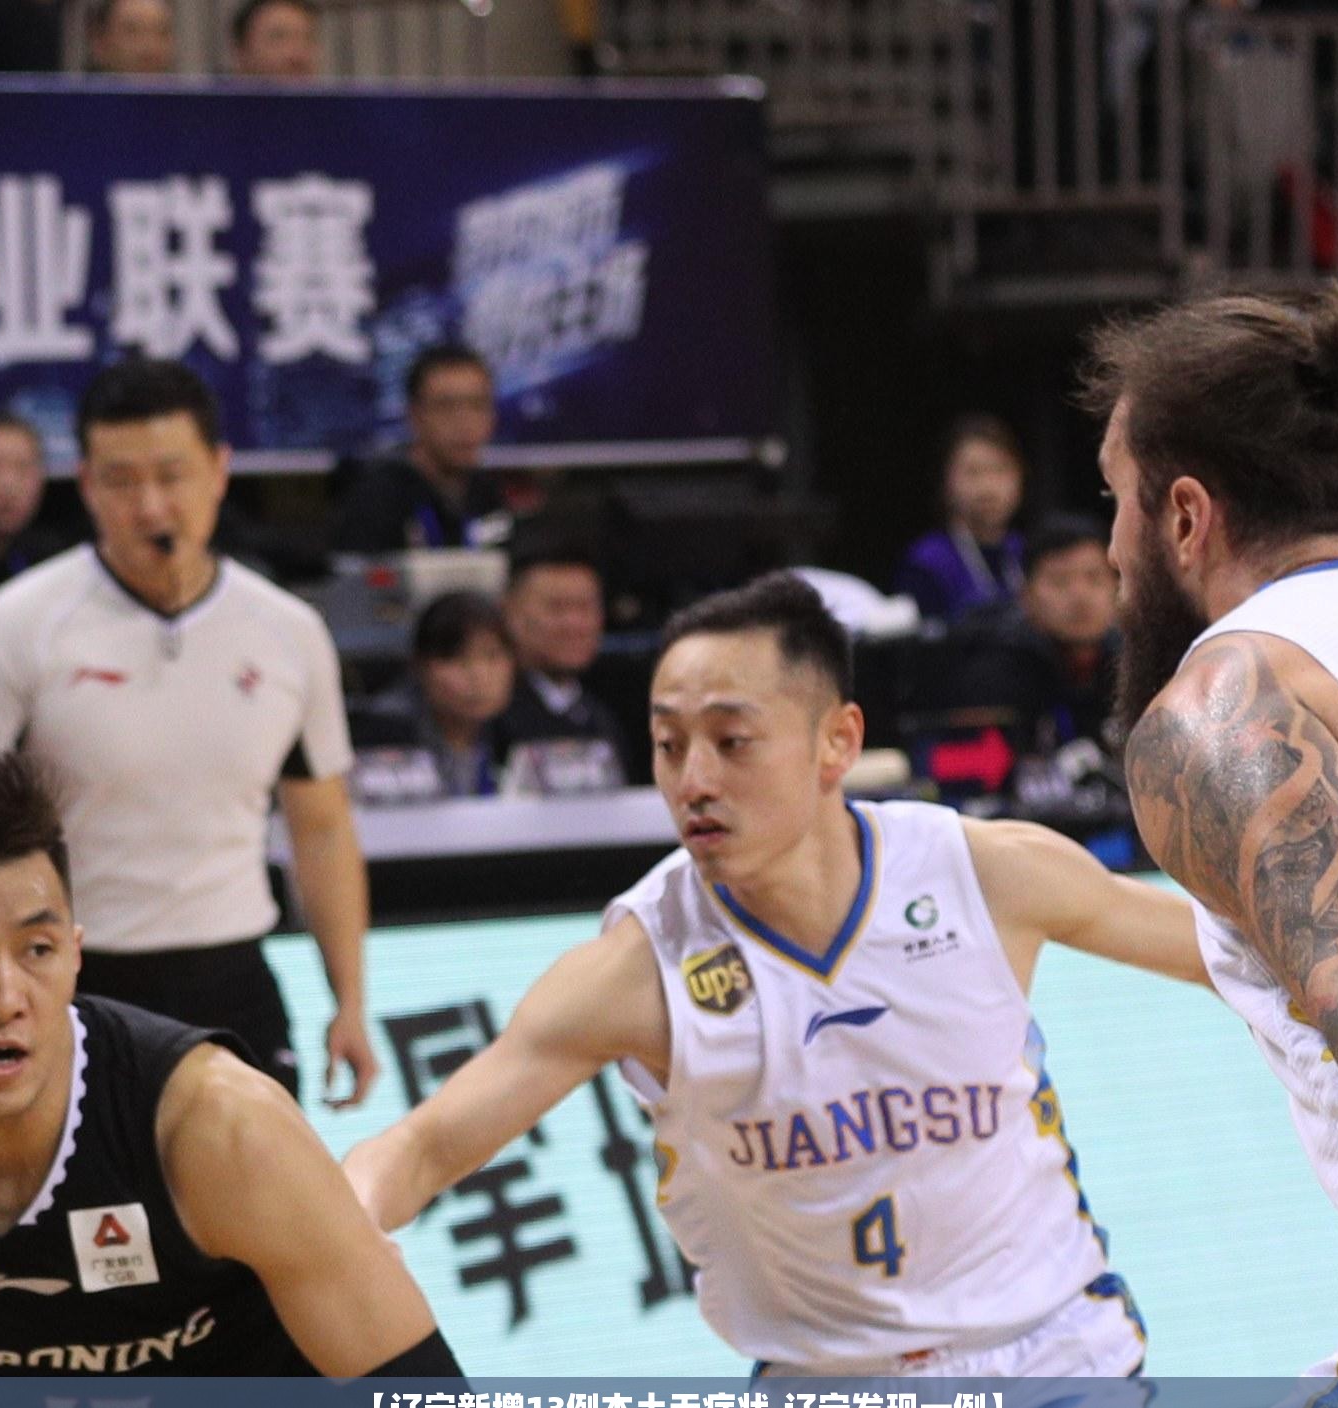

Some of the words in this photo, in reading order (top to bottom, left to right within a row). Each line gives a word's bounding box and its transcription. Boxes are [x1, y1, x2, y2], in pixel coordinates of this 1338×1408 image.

[689, 960, 749, 1007] ups
[728, 1084, 1004, 1171] JIANGSU
[851, 1194, 906, 1278] 4
